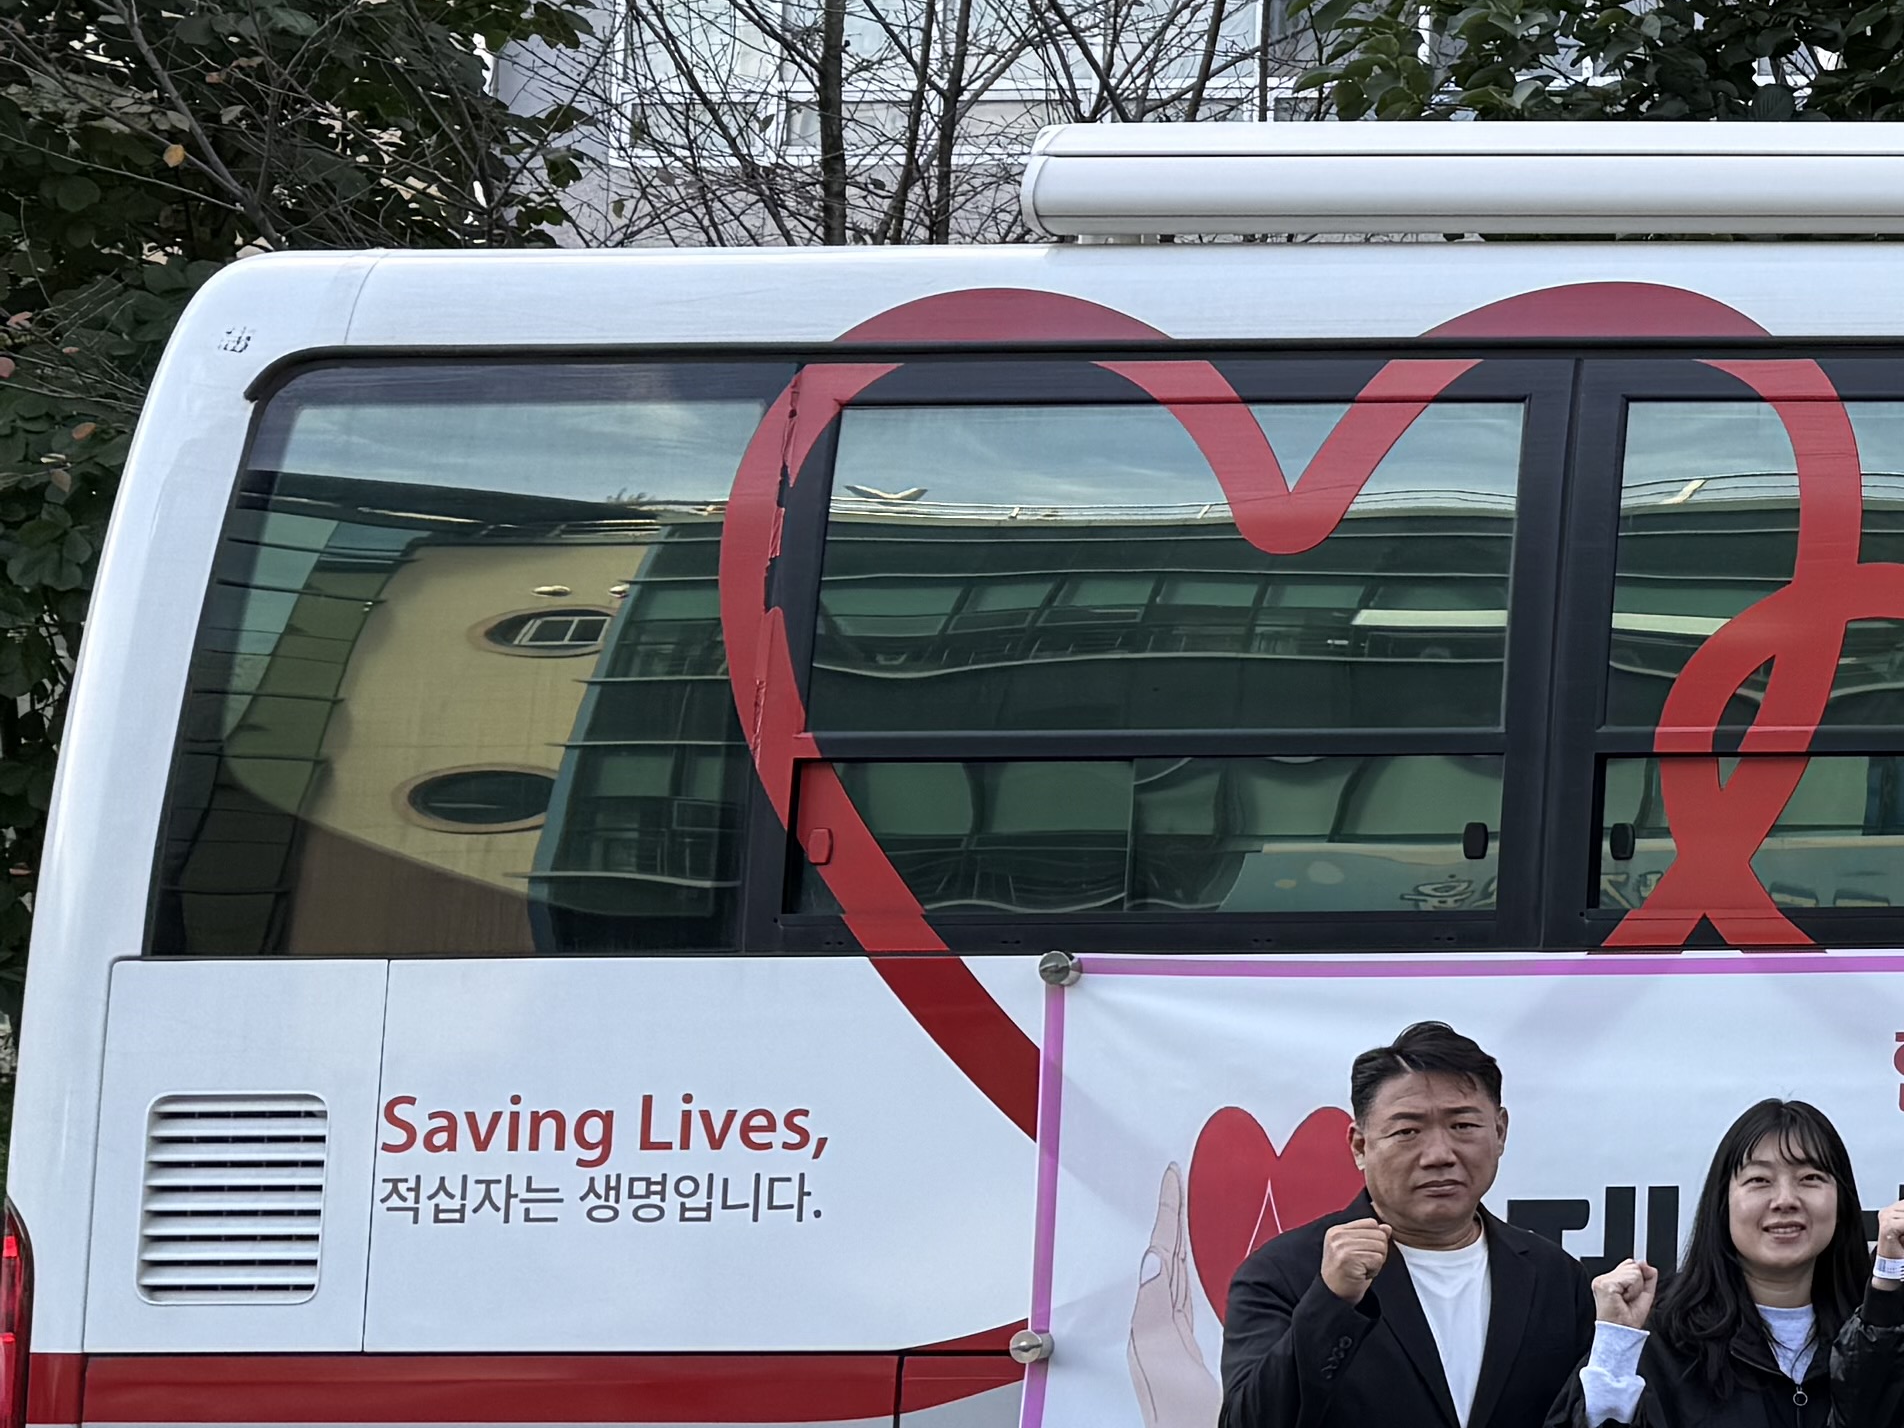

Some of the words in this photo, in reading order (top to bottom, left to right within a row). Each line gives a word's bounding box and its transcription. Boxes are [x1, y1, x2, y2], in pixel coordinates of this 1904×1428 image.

[380, 1095, 614, 1168] Saving
[639, 1092, 830, 1160] Lives,
[378, 1173, 564, 1225] 적십자는
[578, 1172, 823, 1224] 생명입니다.
